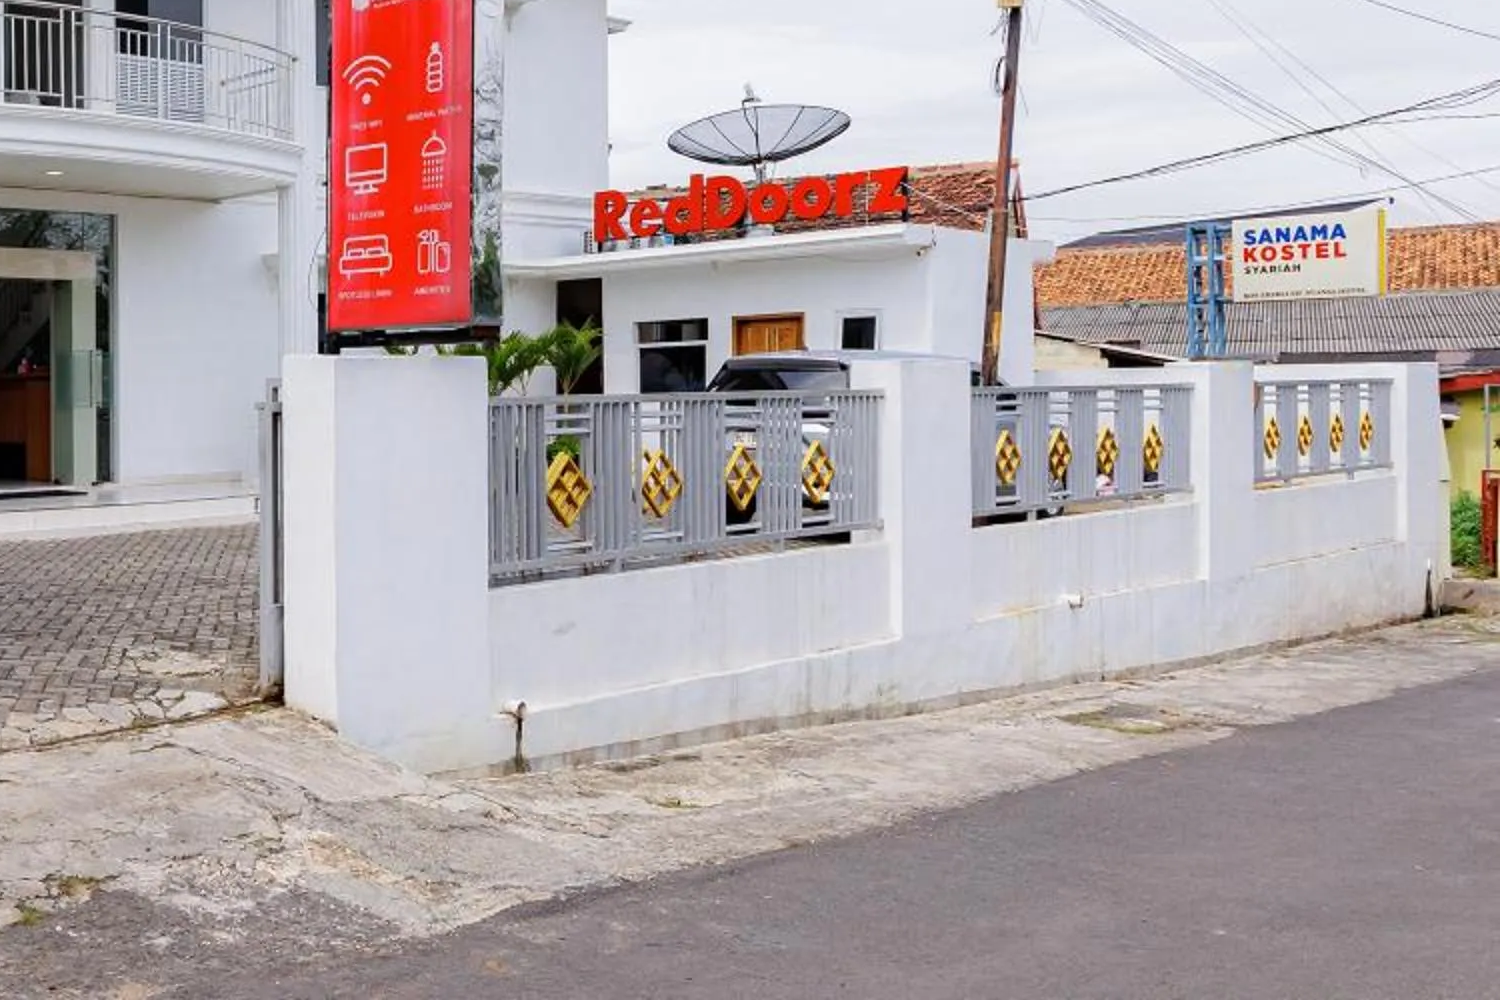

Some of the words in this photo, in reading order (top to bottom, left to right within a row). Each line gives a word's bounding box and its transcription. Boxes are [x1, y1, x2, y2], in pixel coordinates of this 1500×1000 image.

[594, 166, 908, 242] RedDoorz
[1243, 223, 1347, 246] SANAMA
[1243, 241, 1347, 262] KOSTEL
[1244, 263, 1301, 275] SYARIAH
